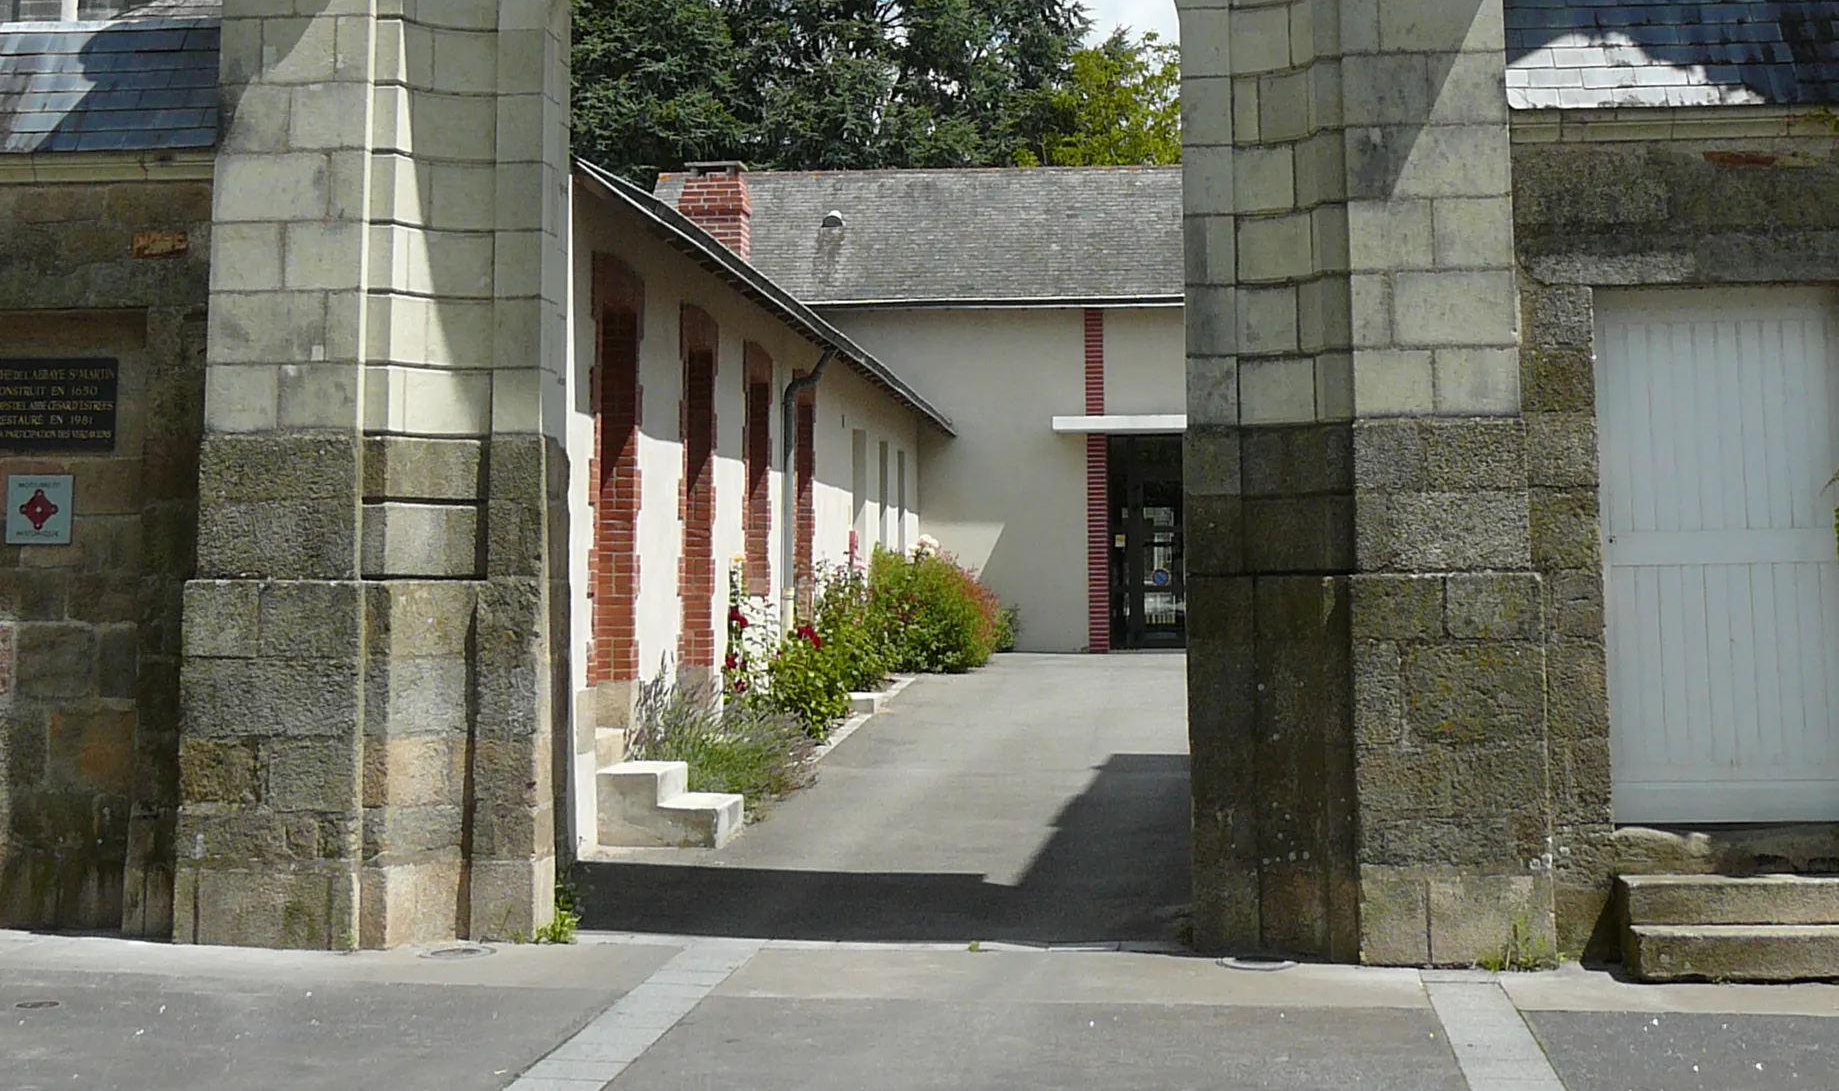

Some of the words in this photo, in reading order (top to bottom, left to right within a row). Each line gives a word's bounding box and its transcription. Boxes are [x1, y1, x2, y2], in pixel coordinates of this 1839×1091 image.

[51, 385, 65, 396] EN
[71, 385, 99, 396] 1650
[50, 415, 64, 426] EN
[71, 415, 93, 426] 1981
